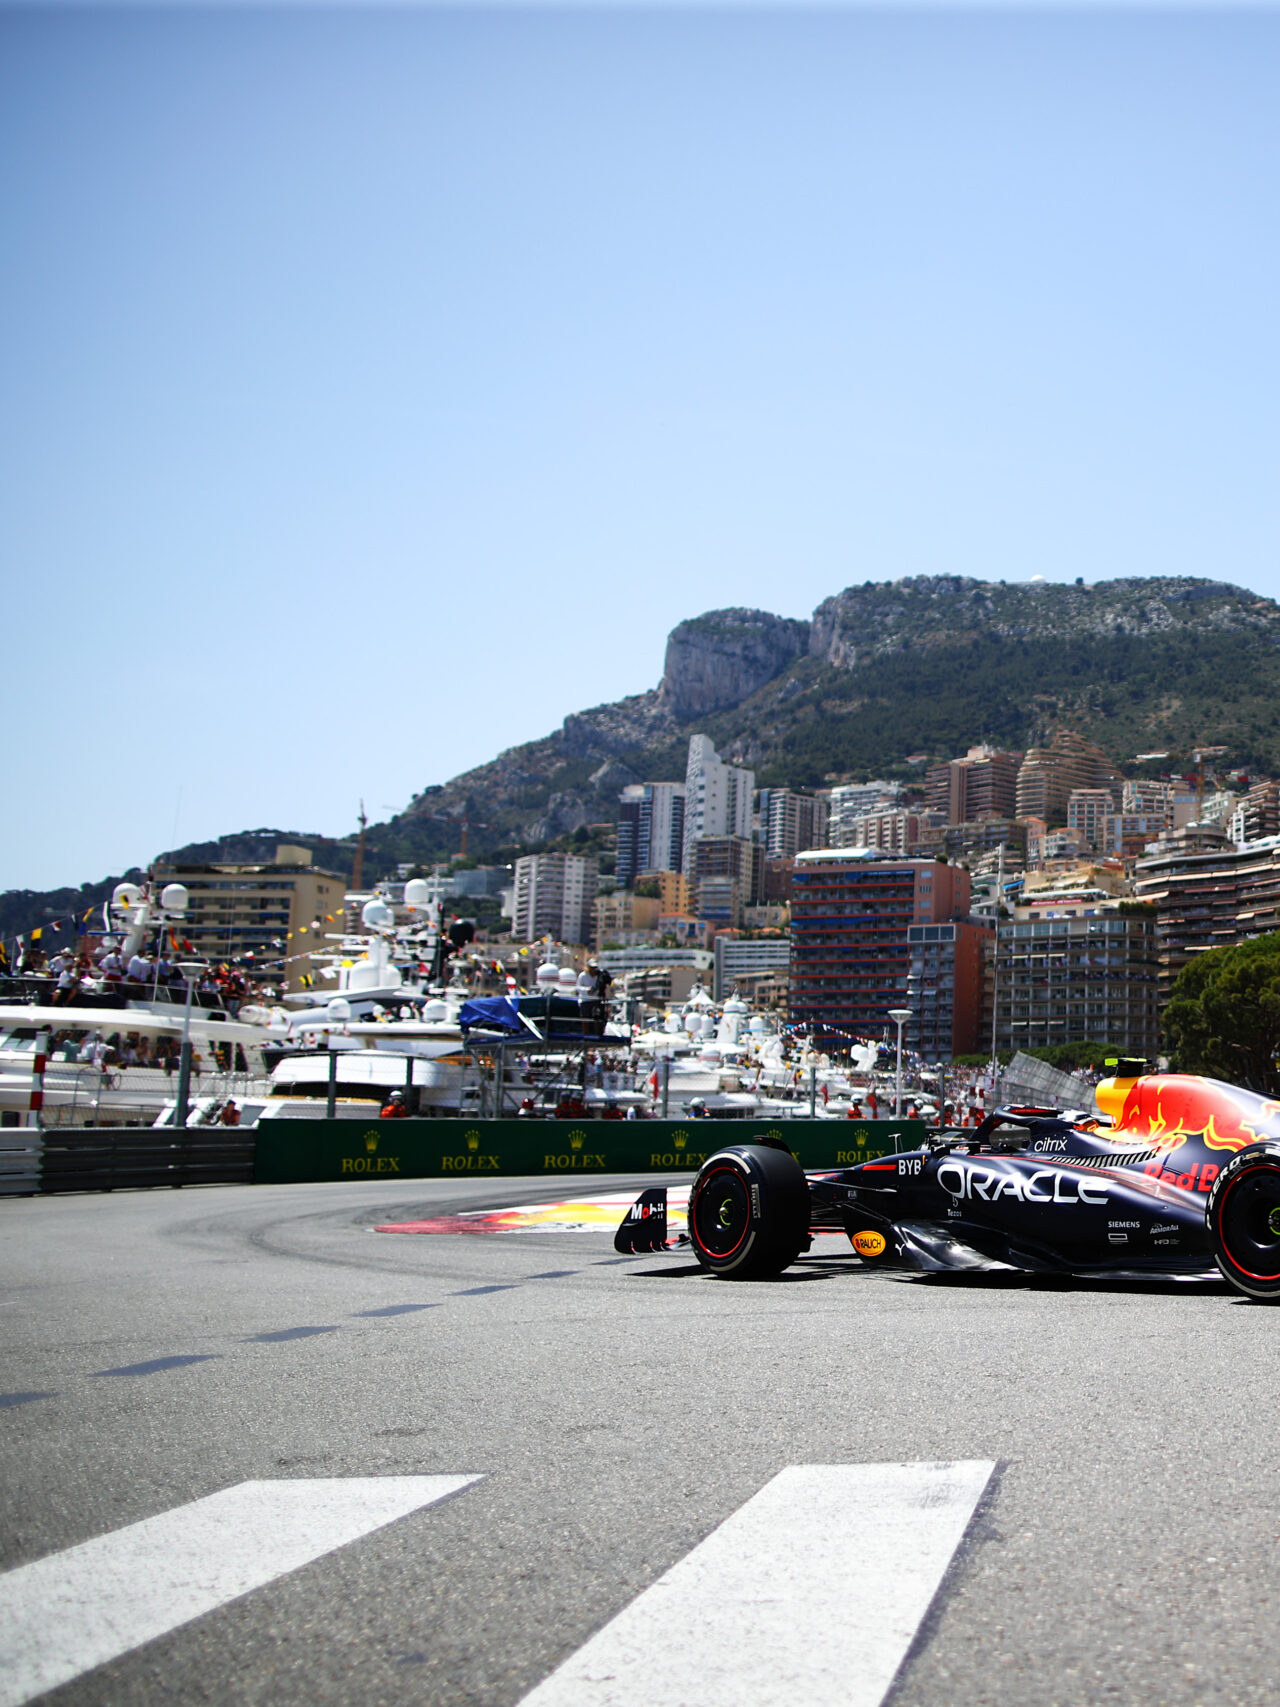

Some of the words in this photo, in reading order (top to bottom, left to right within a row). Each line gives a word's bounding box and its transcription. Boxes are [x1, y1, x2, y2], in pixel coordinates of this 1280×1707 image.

[1034, 1137, 1068, 1152] citrix
[341, 1158, 400, 1173] ROLEX
[441, 1156, 500, 1170] ROLEX
[543, 1155, 607, 1168] ROLEX
[650, 1153, 708, 1167] ROLEX
[937, 1163, 1109, 1205] ORACLE
[1144, 1163, 1199, 1191] Red
[1207, 1155, 1241, 1211] ZERO
[859, 1238, 882, 1249] RAUCH
